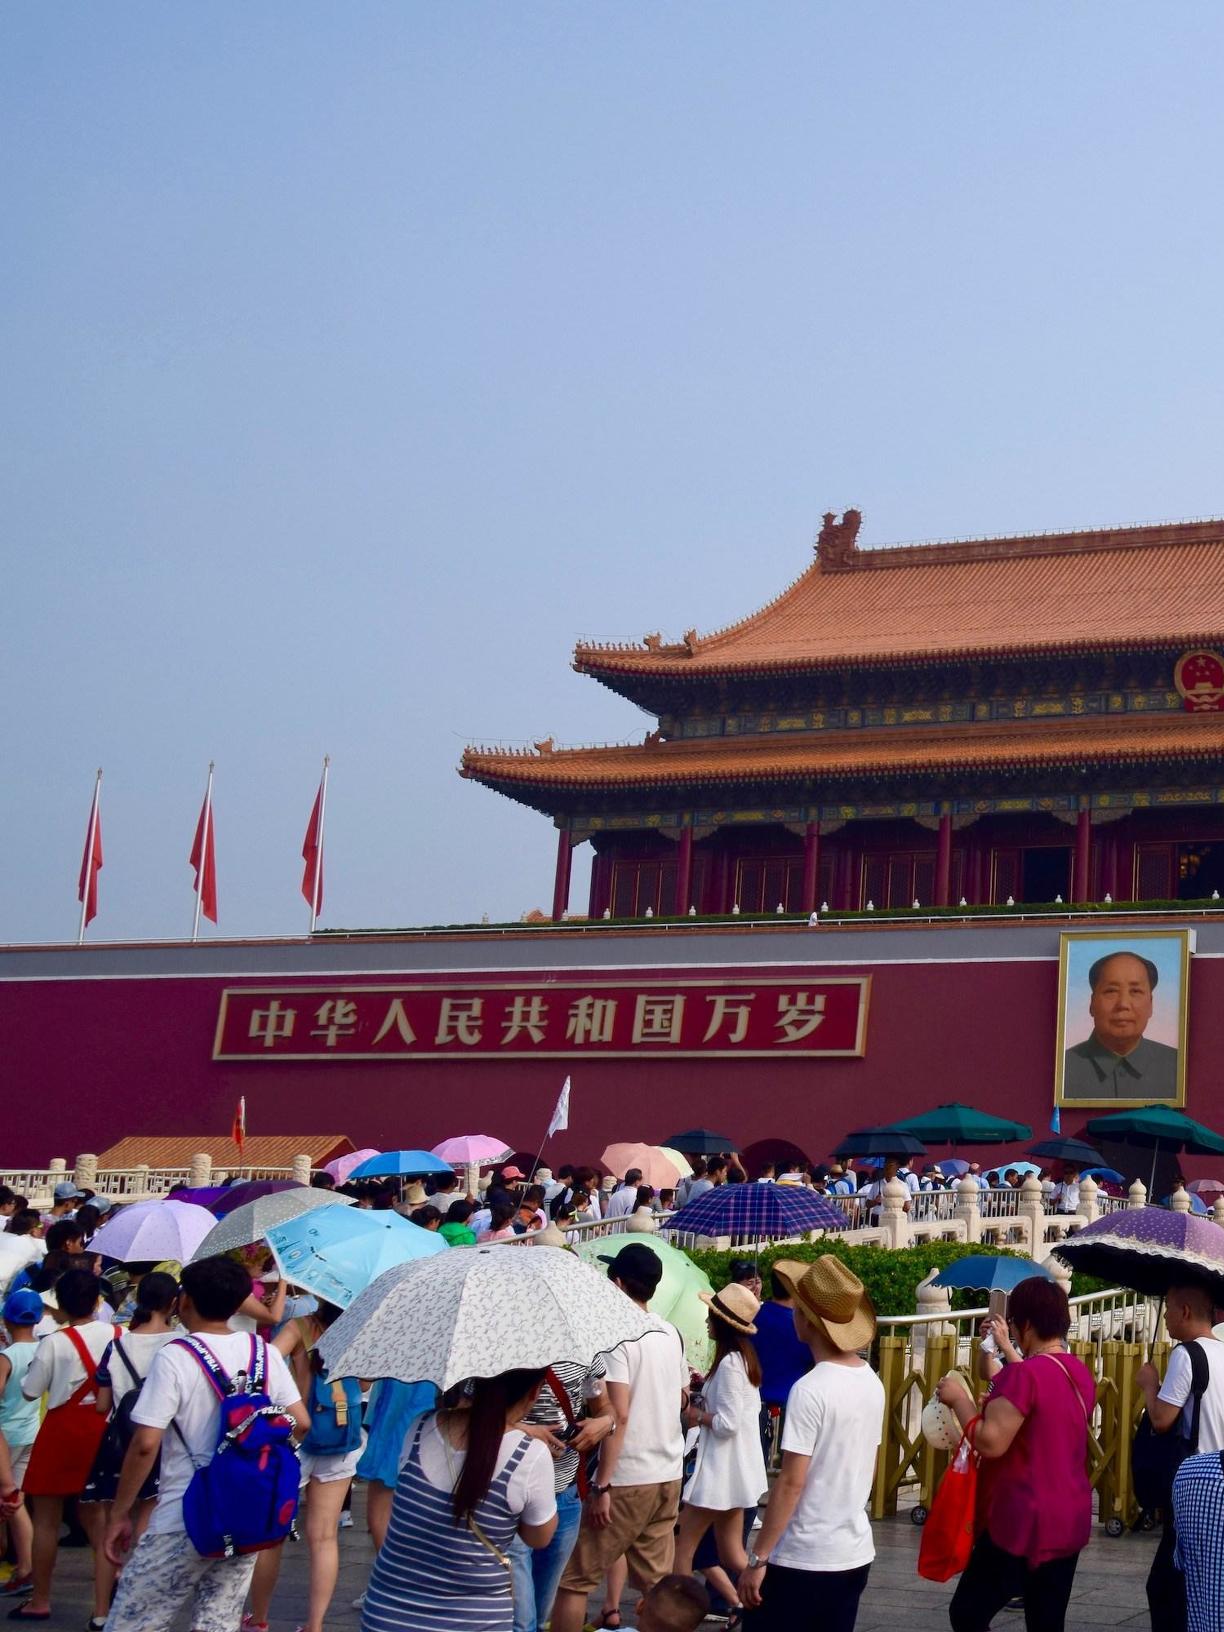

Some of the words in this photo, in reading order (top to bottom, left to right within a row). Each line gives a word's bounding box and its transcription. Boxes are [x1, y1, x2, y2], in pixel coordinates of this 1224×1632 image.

[248, 991, 827, 1047] 中华人民共和国万岁
